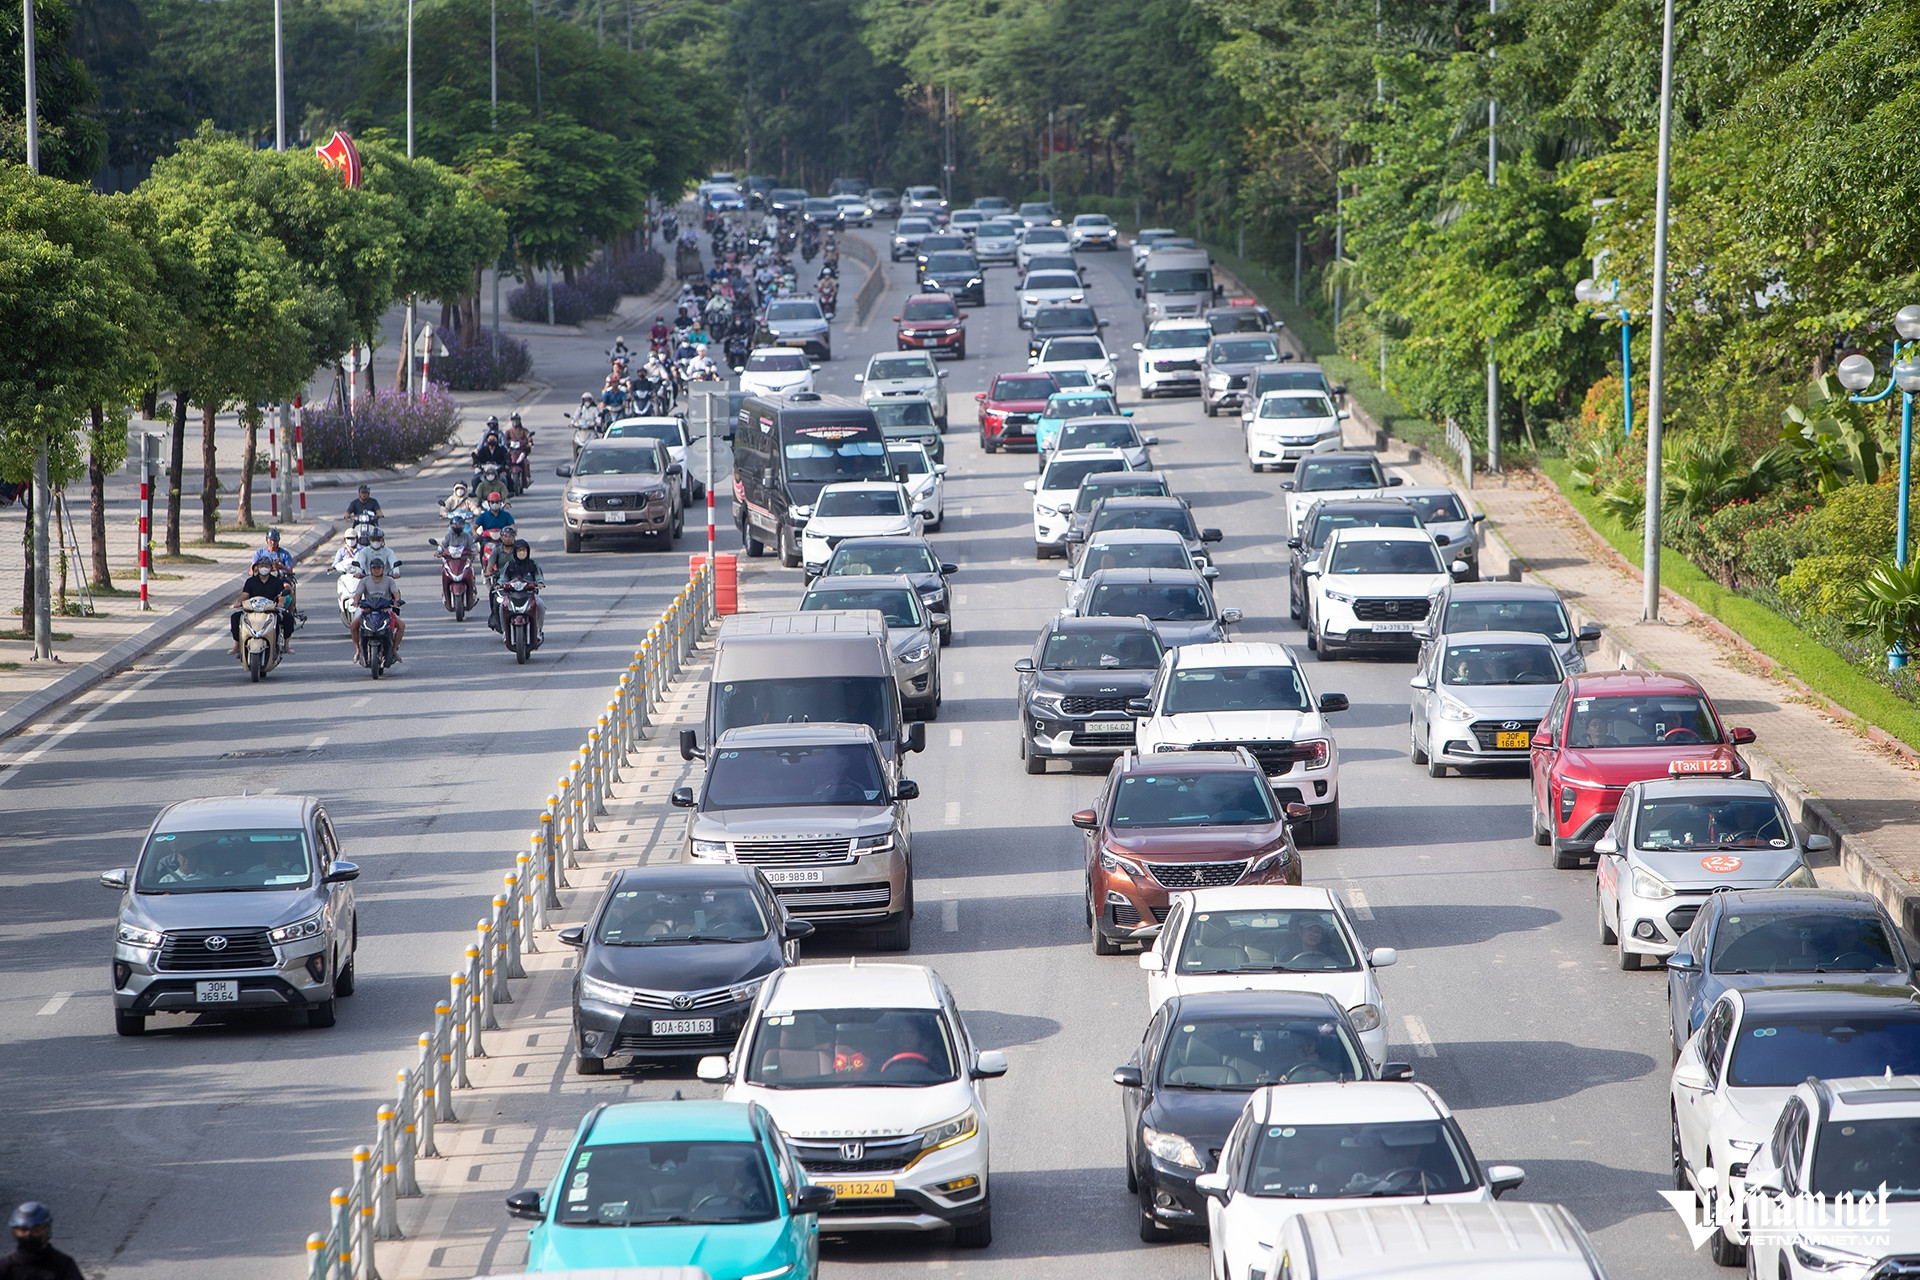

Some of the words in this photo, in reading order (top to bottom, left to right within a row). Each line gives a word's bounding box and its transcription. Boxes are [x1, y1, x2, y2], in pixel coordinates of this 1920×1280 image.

[1089, 723, 1130, 732] 30K-164.02
[1506, 732, 1520, 740] 30F
[1675, 760, 1699, 771] Taxi
[1702, 760, 1728, 771] 123
[768, 872, 819, 882] 30B-989.89
[207, 982, 226, 992] 30H
[201, 992, 234, 1001] 369.64
[654, 1020, 712, 1034] 30A-631.63
[802, 1128, 904, 1137] DISCOVERY
